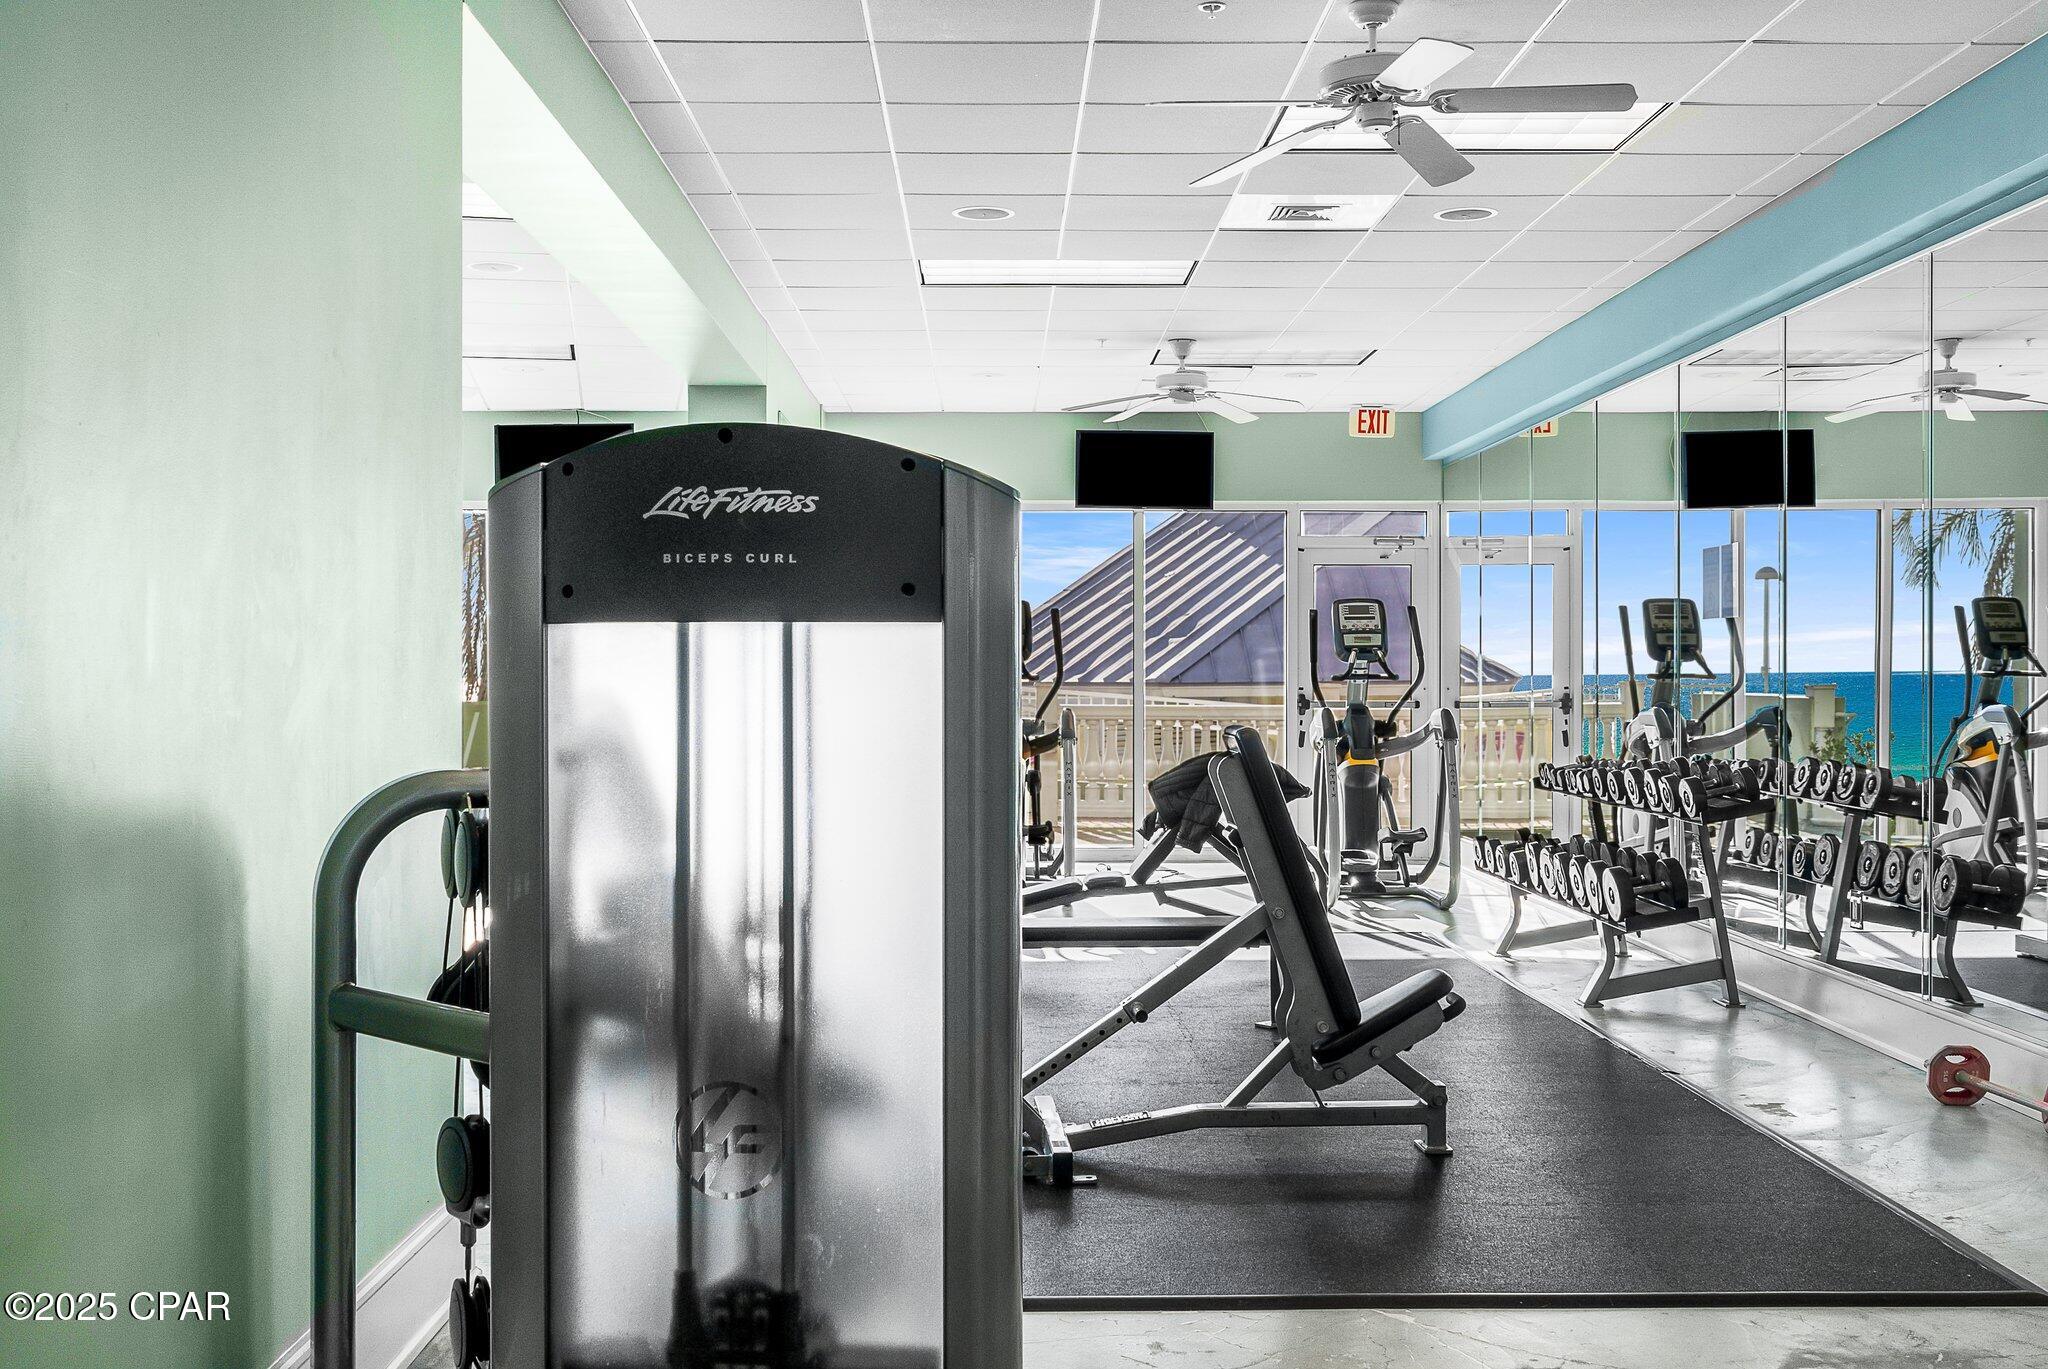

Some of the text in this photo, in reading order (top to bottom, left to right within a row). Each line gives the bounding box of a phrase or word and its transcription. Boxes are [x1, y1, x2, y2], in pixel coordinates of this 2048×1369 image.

[1357, 409, 1390, 434] EXIT
[663, 553, 797, 563] BICEPS CURL
[1328, 762, 1337, 798] MATRIX
[1448, 762, 1458, 799] MATRIX
